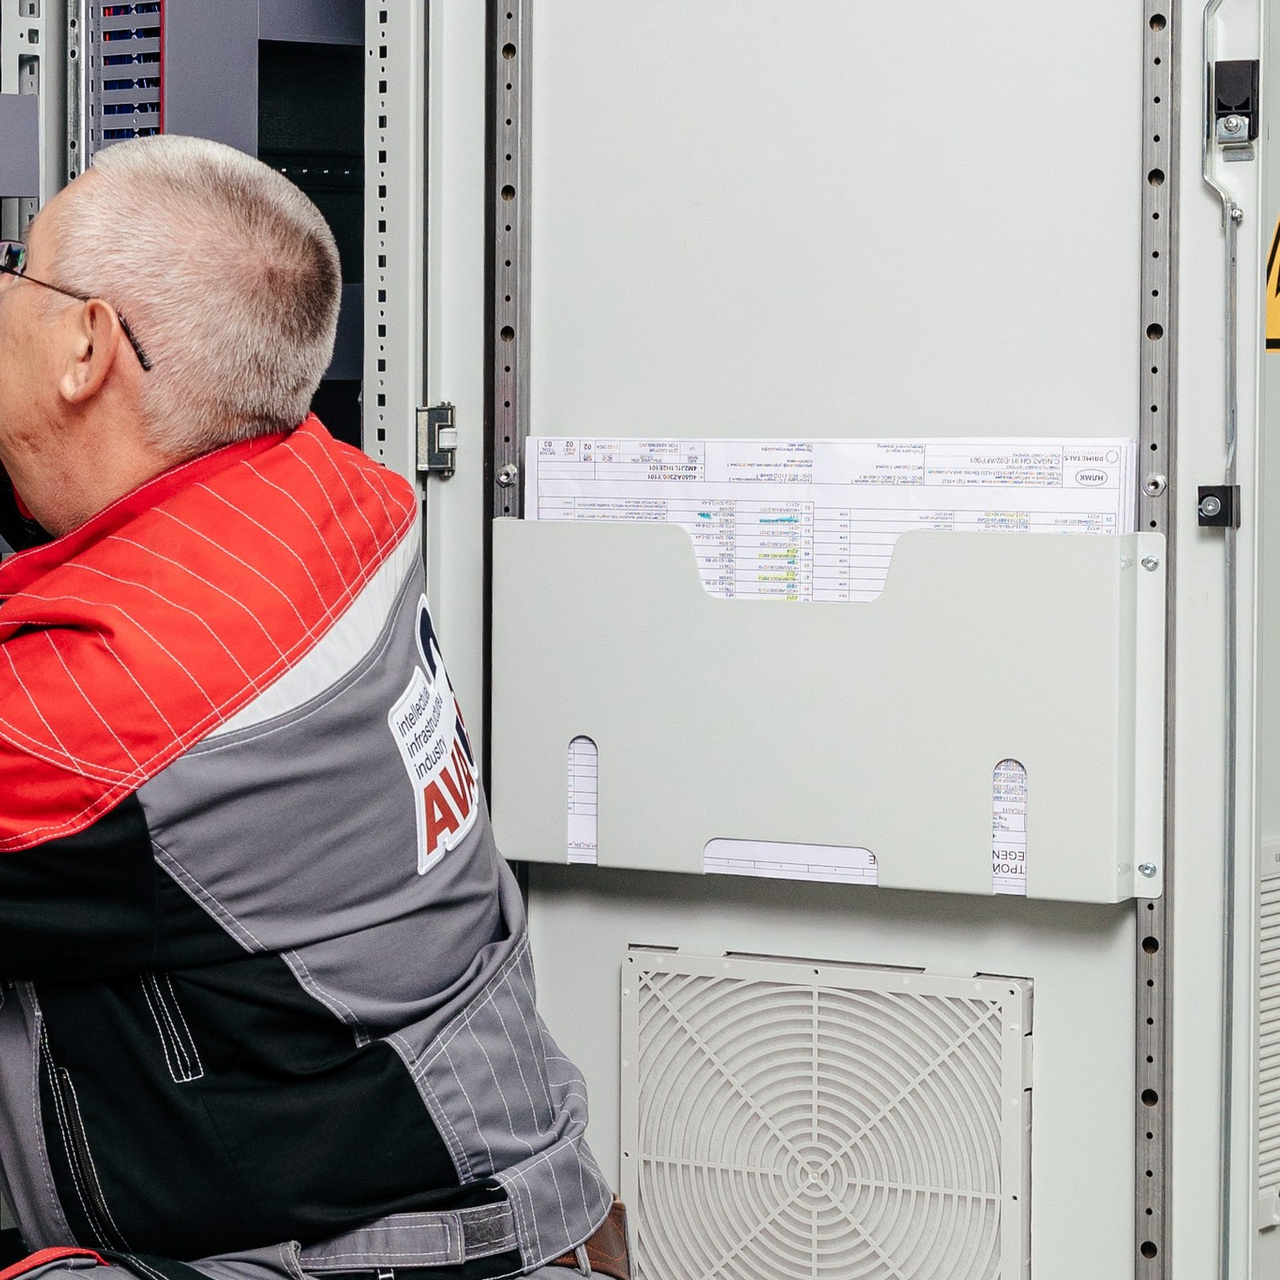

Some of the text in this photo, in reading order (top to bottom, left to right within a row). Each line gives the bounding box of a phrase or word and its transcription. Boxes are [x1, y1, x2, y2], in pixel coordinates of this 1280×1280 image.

[565, 440, 574, 448] 02
[583, 443, 592, 451] 02
[1064, 454, 1104, 462] PRIMETALS
[1078, 473, 1105, 483] НЛМК
[396, 681, 430, 738] intellectual
[414, 734, 448, 780] industry
[992, 850, 1026, 861] EGEN
[992, 863, 1026, 875] ТРОЙ
